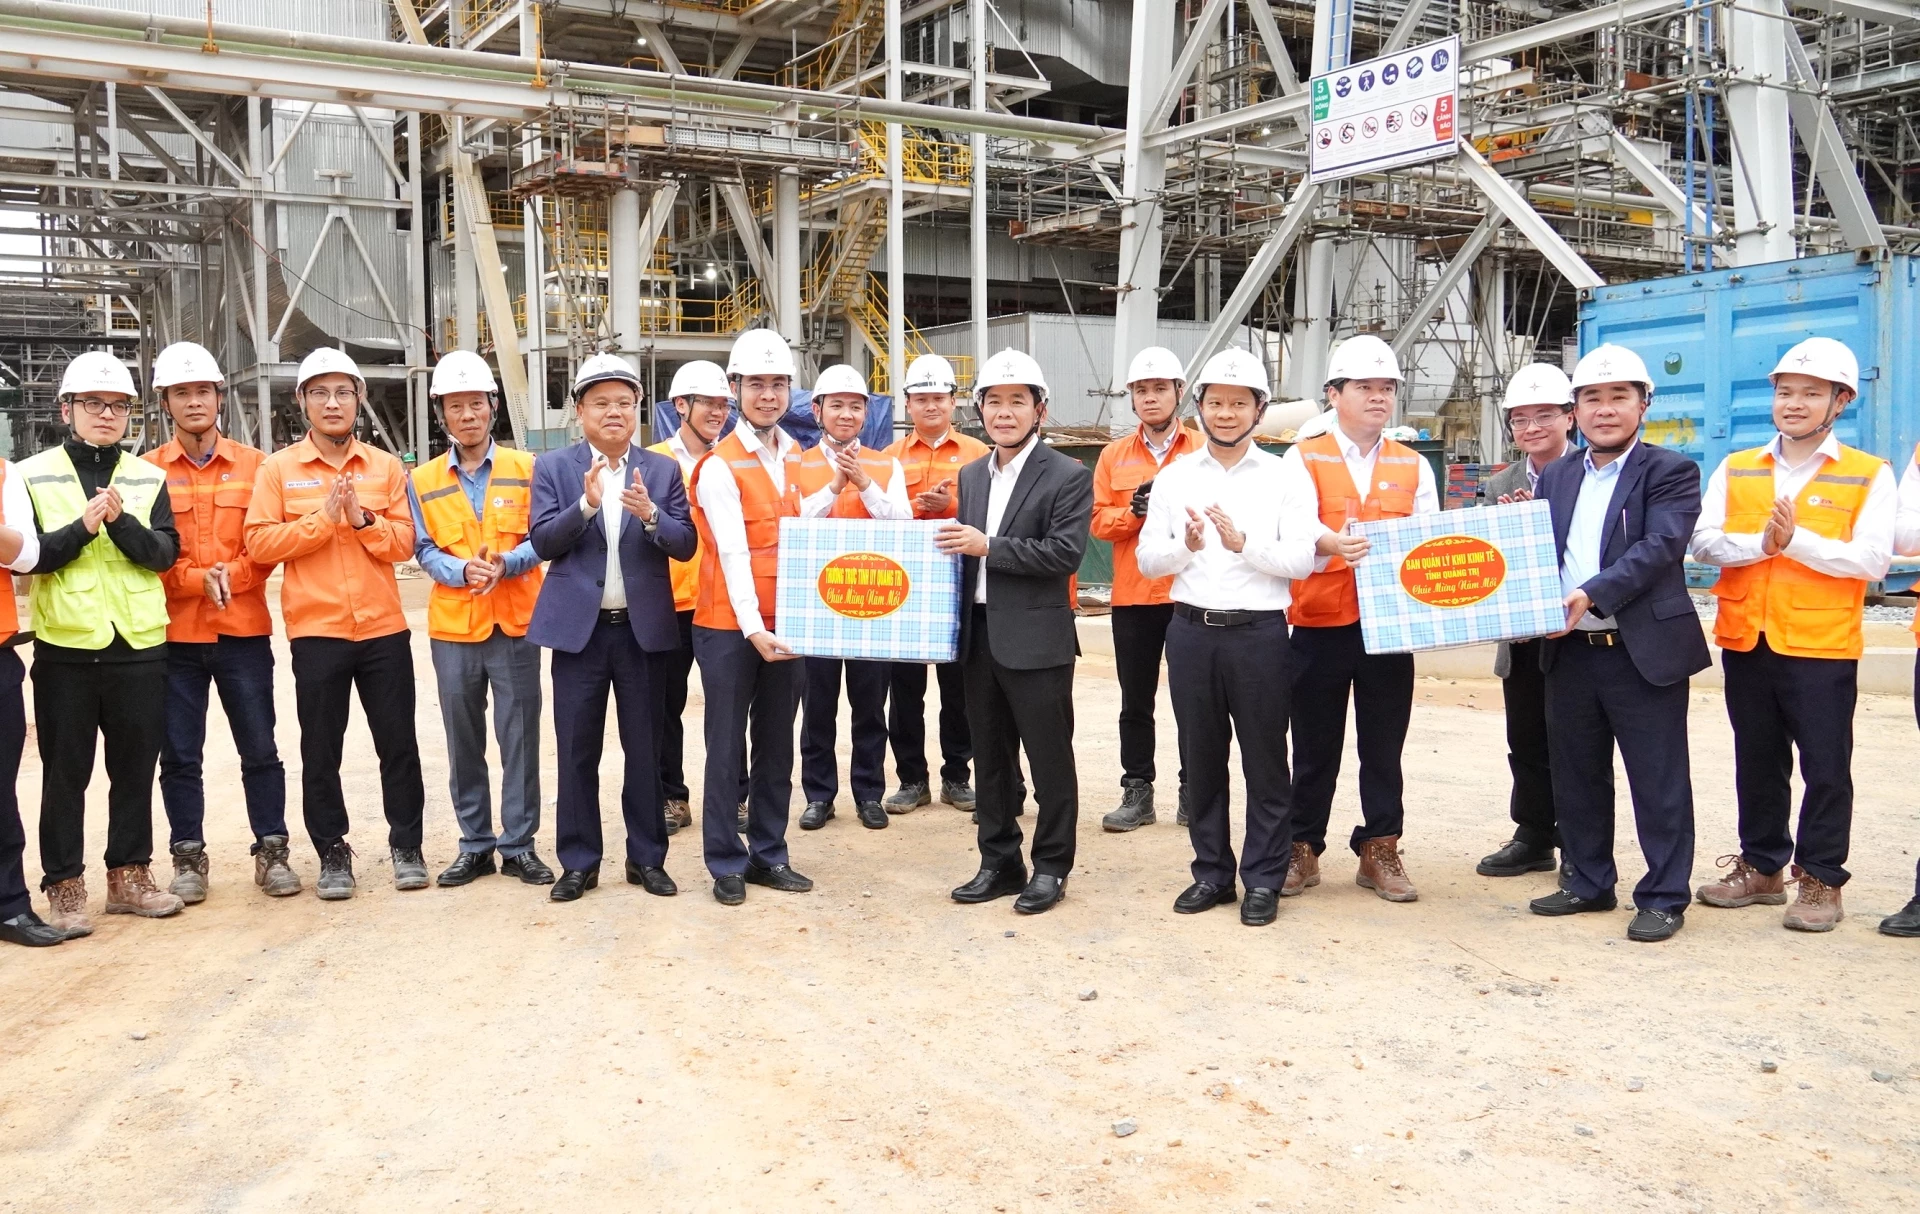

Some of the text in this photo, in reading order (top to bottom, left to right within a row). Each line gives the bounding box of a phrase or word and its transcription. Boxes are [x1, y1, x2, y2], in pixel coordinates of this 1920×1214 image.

[1317, 82, 1324, 93] 5
[1440, 99, 1448, 112] 5
[1406, 548, 1495, 570] BAN QUẢN LÝ KHU KINH TẾ
[1425, 567, 1480, 581] TỈNH QUẢNG TRỊ
[1412, 576, 1498, 596] Chúc Mừng Năm Mới
[826, 585, 902, 608] Chúc Mừng Năm Mới
